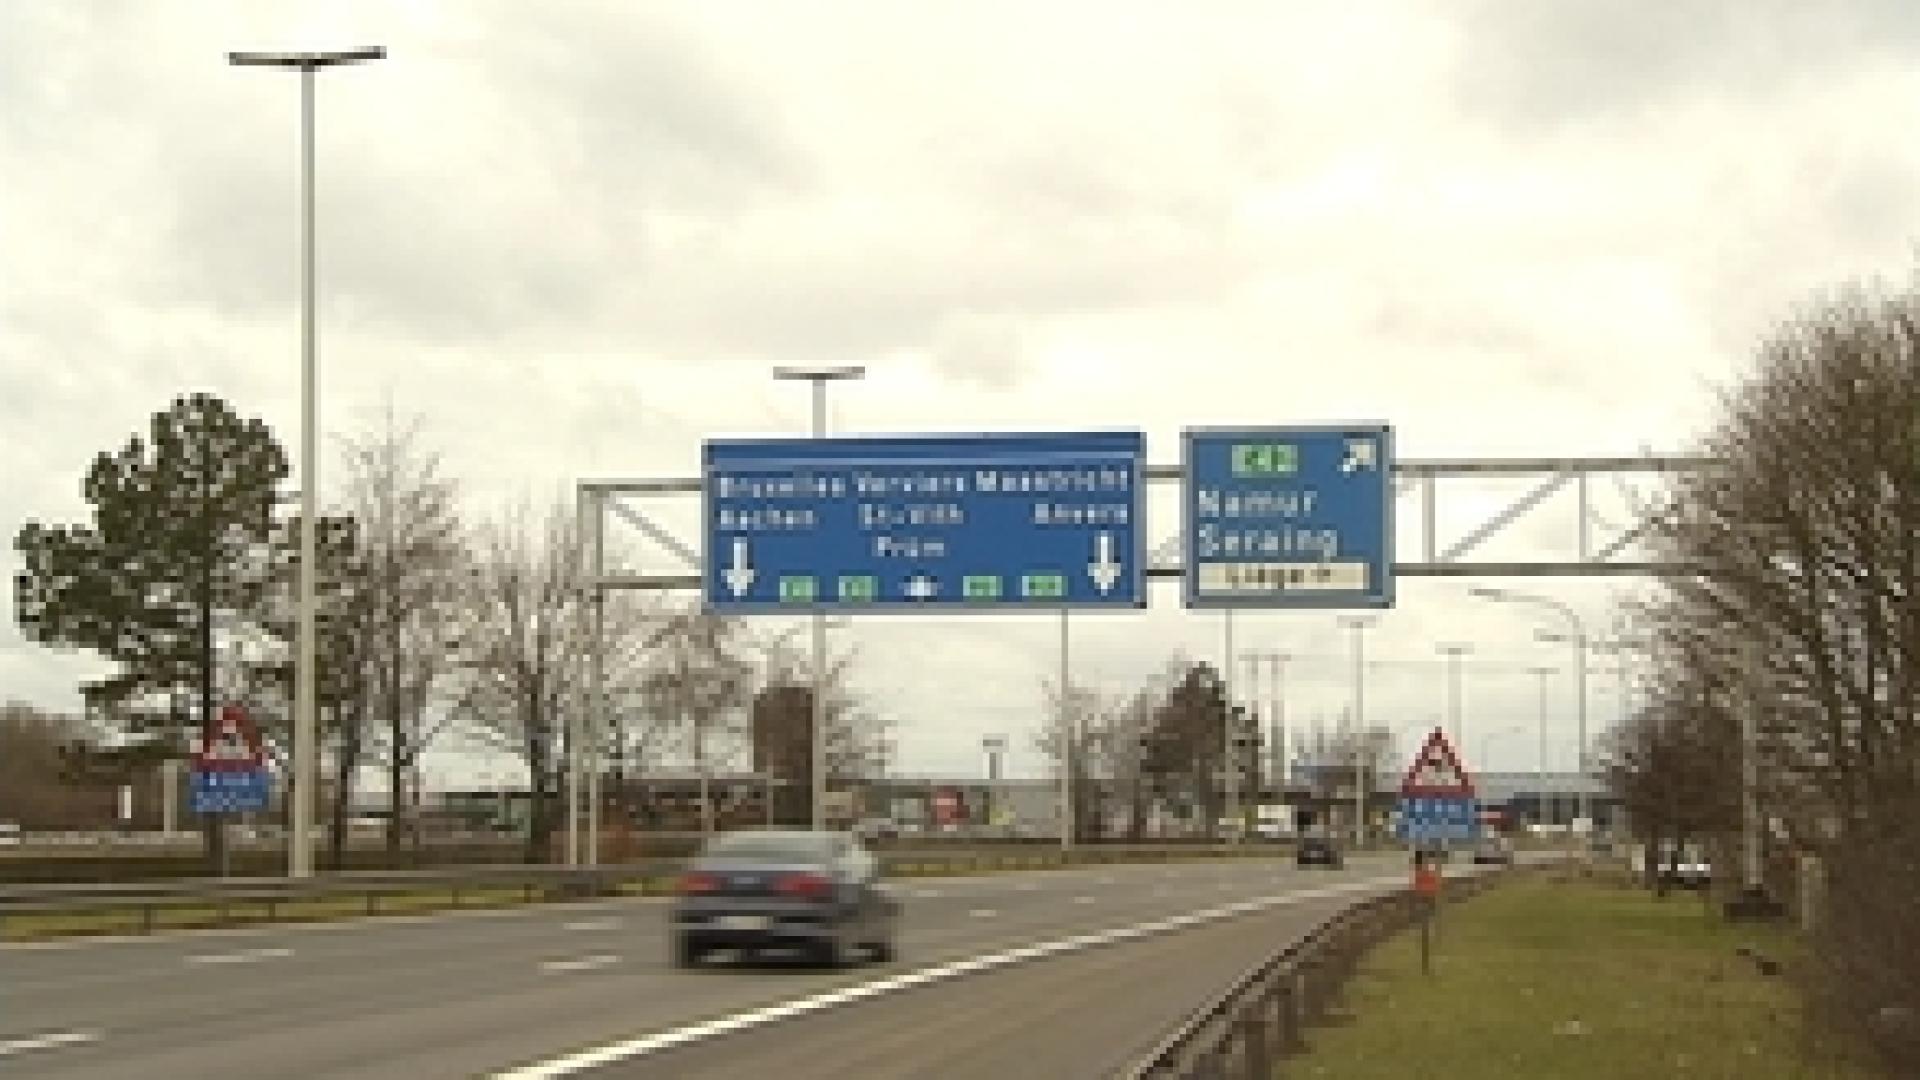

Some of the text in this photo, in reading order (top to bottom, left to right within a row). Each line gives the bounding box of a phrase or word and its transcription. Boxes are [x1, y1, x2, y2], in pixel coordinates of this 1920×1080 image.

[852, 472, 968, 496] Verviers
[976, 470, 1128, 492] Maastricht
[1199, 488, 1317, 517] Namur
[720, 506, 816, 530] Aachen
[1199, 525, 1337, 561] Seraing
